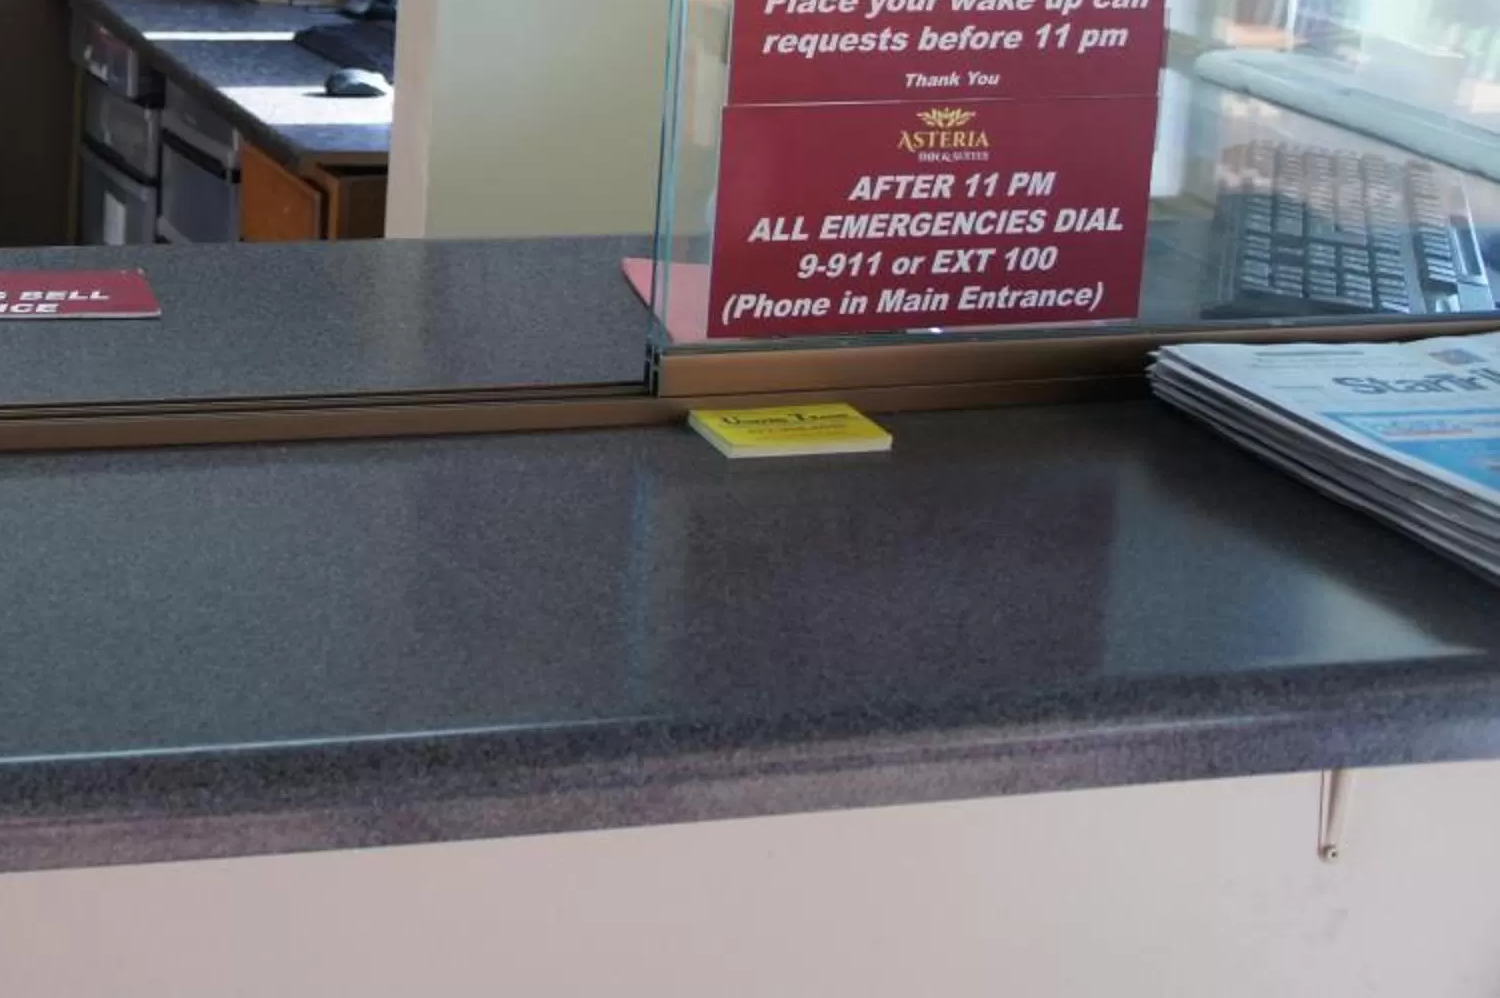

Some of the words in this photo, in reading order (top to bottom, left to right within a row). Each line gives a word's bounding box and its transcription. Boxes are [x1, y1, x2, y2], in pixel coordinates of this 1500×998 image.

[762, 26, 908, 59] requests
[917, 25, 1023, 52] before
[1035, 24, 1070, 49] 11
[1077, 29, 1128, 55] pm
[905, 71, 960, 89] Thank
[967, 70, 1000, 87] You
[896, 129, 990, 154] ASTERIA
[848, 175, 953, 202] AFTER
[964, 173, 996, 198] 11
[1007, 171, 1056, 197] PM
[747, 216, 810, 243] ALL
[819, 208, 1046, 240] EMERGENCIES
[1053, 207, 1124, 234] DIAL
[796, 252, 882, 280] 9-911
[891, 256, 924, 275] or
[930, 248, 995, 274] EXT
[1004, 245, 1058, 271] 100
[19, 289, 111, 301] BELL
[721, 292, 831, 325] (Phone
[838, 290, 868, 315] in
[877, 287, 949, 313] Main
[957, 281, 1105, 311] Entrance)
